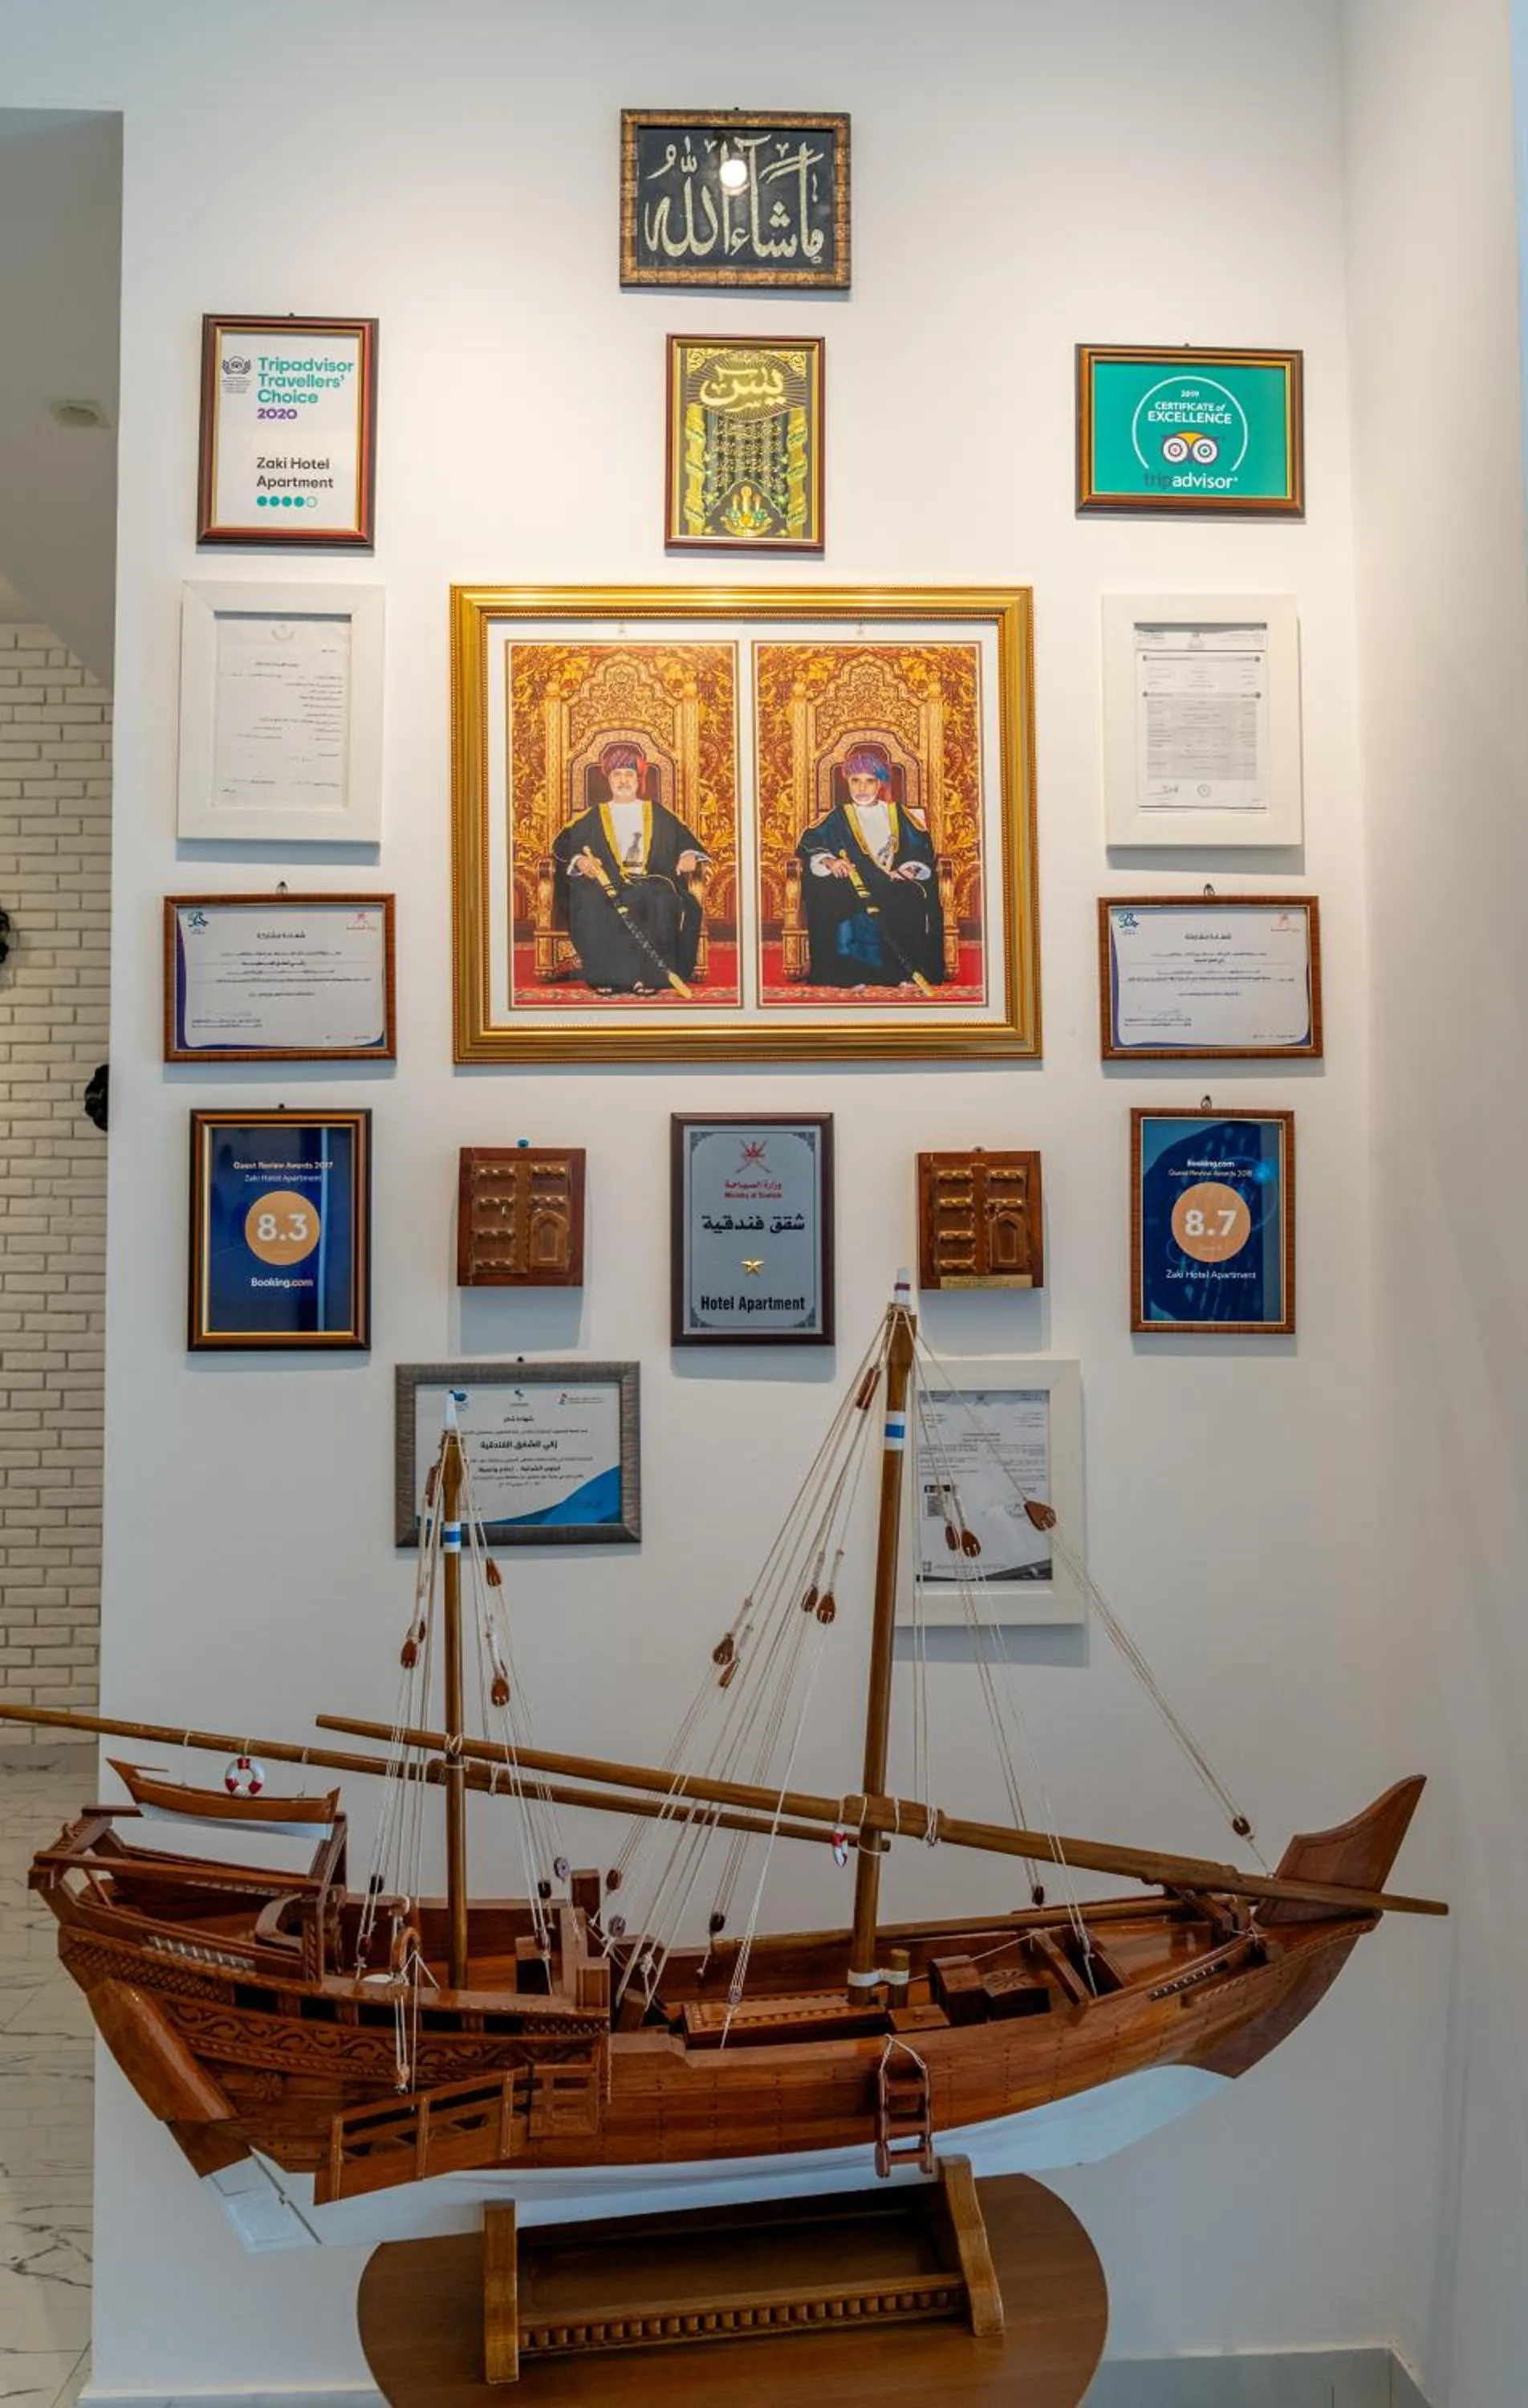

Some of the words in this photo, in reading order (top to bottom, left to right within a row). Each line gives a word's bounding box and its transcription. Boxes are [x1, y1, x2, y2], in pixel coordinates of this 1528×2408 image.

[258, 356, 354, 374] Tripadvisor
[258, 372, 344, 388] Travellers'
[257, 389, 319, 404] Choice
[1156, 401, 1214, 411] CERTIFICATE
[1216, 404, 1226, 412] of
[257, 409, 298, 420] 2020
[1148, 411, 1232, 425] EXCELLENCE
[257, 457, 287, 470] Zaki
[291, 458, 330, 470] Hotel
[256, 475, 334, 490] Apartment
[1144, 472, 1233, 490] tripadvisor
[257, 1214, 307, 1241] 8.3
[701, 1215, 765, 1234] فندقية
[770, 1214, 805, 1234] شقق
[1185, 1210, 1237, 1236] 8.7
[1166, 1269, 1184, 1279] Zaki
[1185, 1270, 1209, 1279] Hotel
[1211, 1270, 1256, 1280] Apartment
[251, 1278, 313, 1288] Booking.com
[701, 1296, 734, 1311] Hotel
[738, 1296, 805, 1313] Apartment
